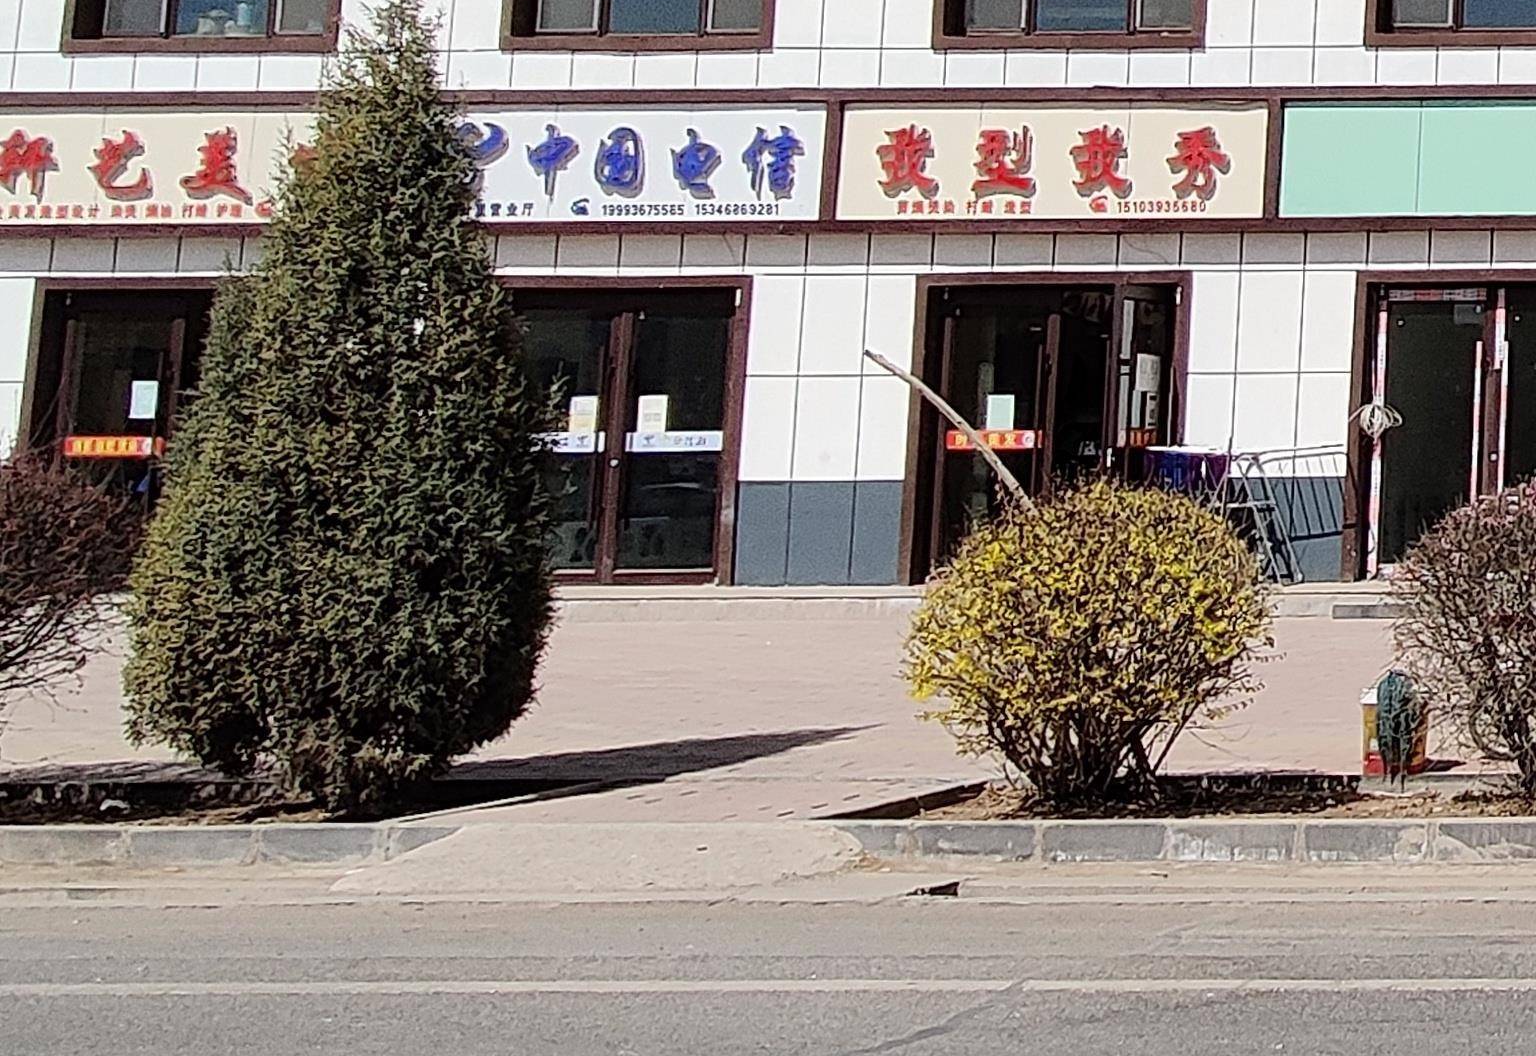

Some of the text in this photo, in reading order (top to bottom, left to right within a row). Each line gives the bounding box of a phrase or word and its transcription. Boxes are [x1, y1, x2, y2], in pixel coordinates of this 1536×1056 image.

[0, 126, 318, 206] 轩艺美
[525, 124, 805, 201] 中国电信
